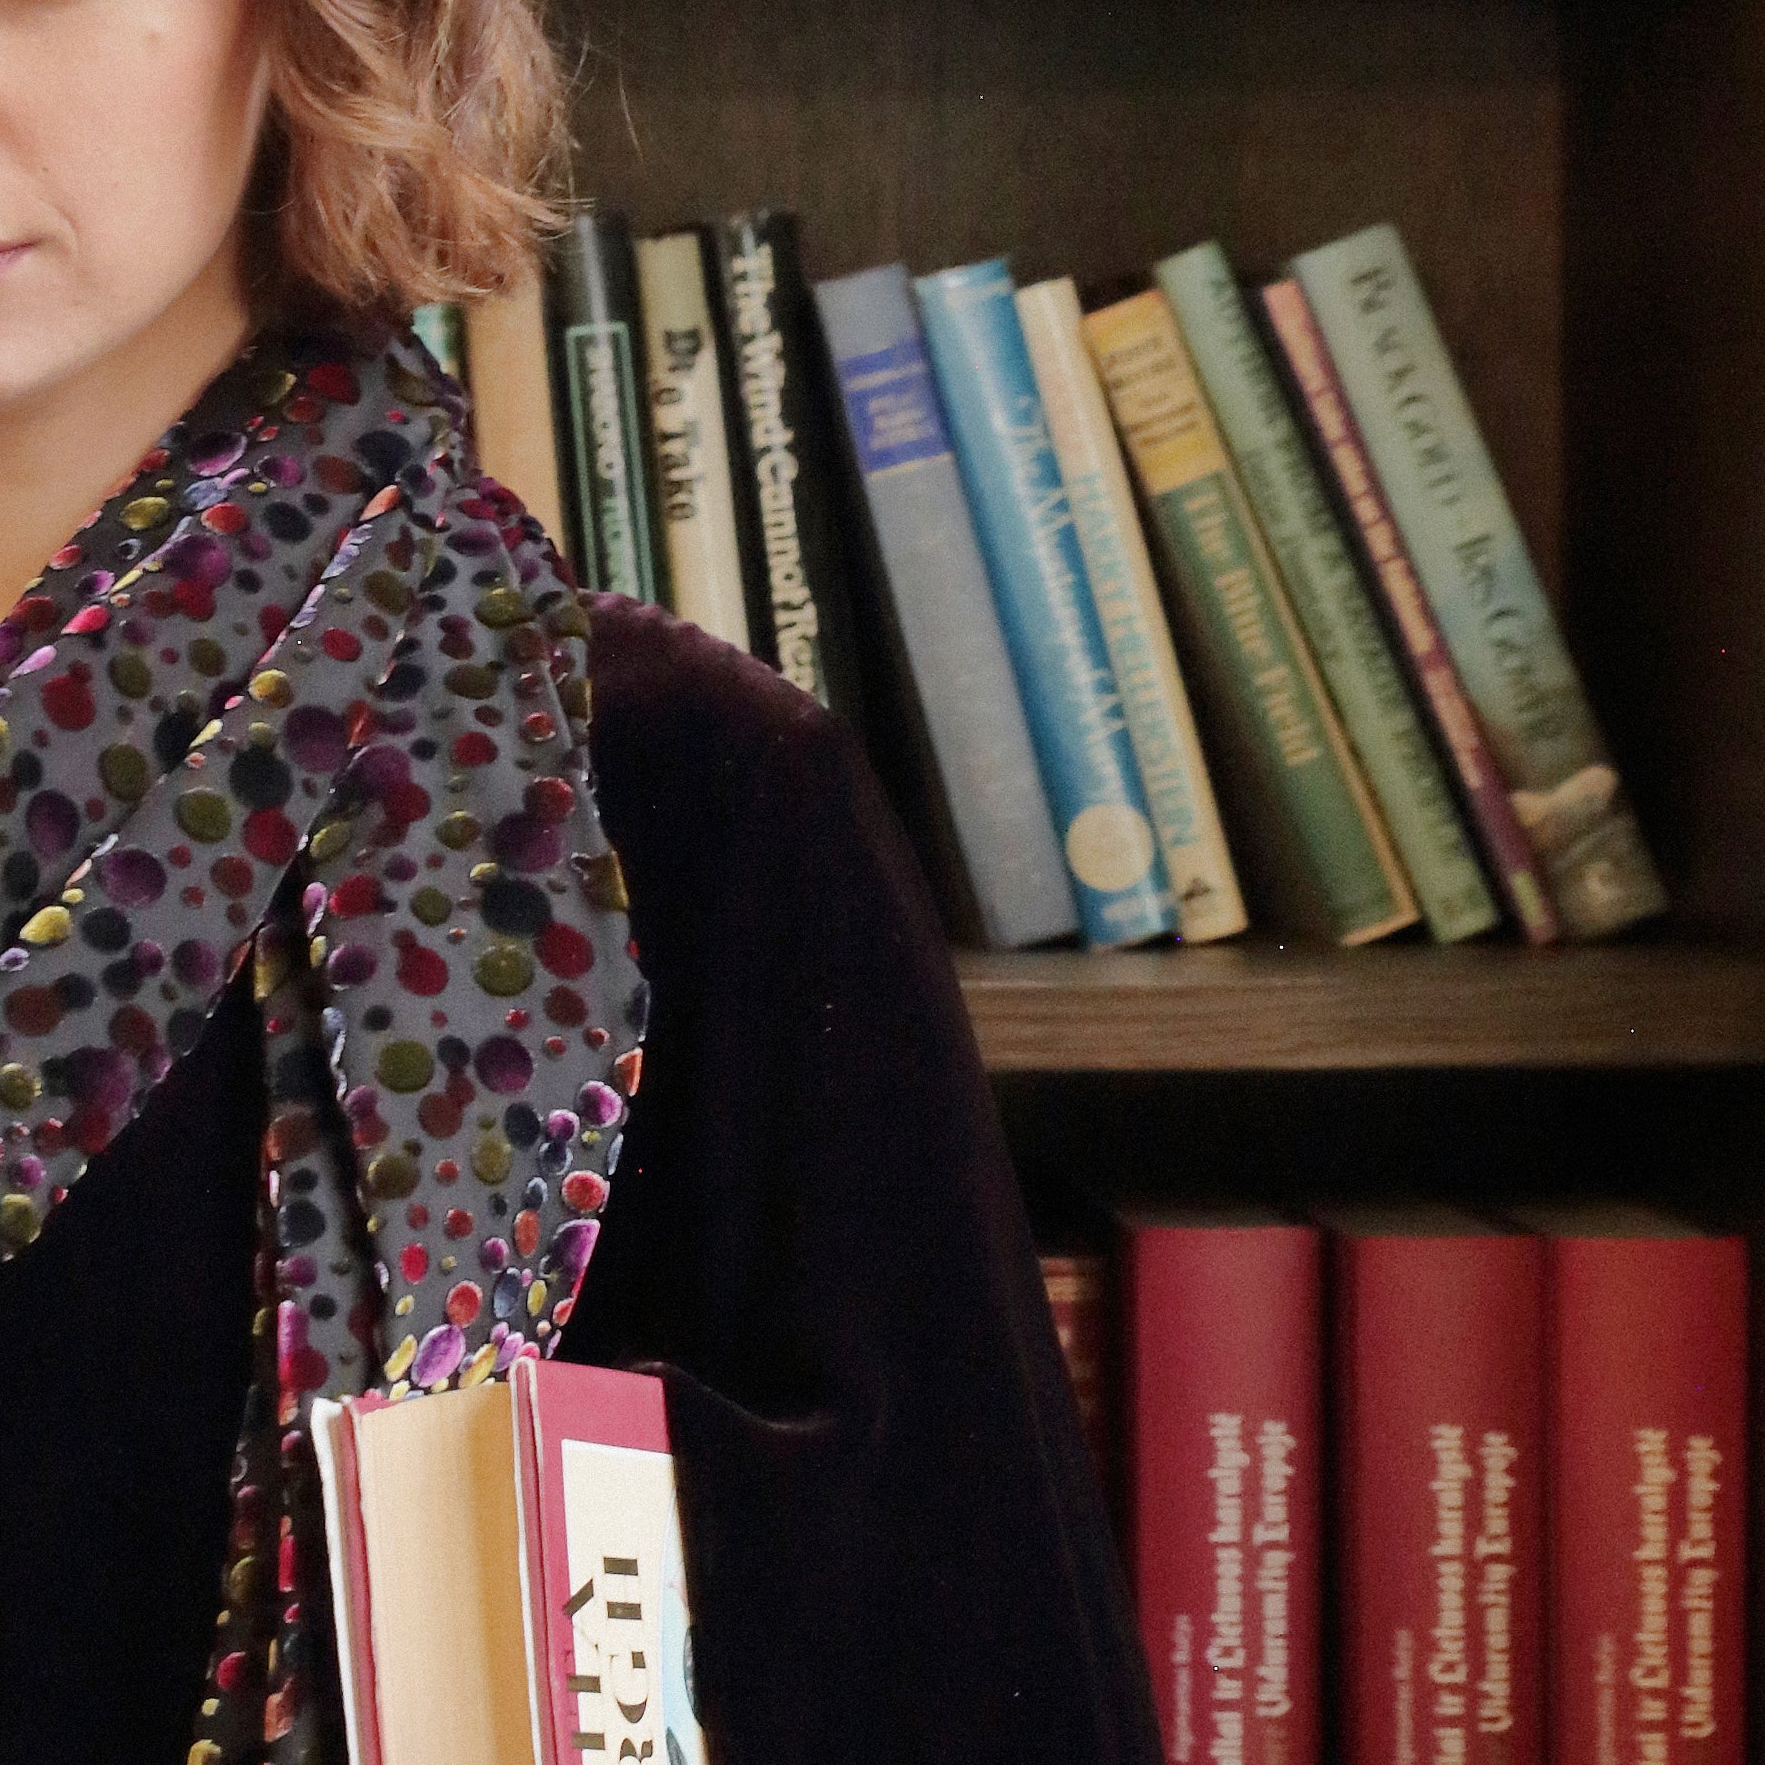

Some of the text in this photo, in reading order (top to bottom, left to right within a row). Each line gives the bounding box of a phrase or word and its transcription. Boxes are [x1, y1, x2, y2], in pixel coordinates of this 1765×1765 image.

[729, 244, 831, 707] The Wind Cannot Rea
[1072, 469, 1138, 605] HARRY
[1180, 488, 1240, 566] The
[1210, 563, 1282, 665] Blue
[1251, 661, 1322, 769] Field
